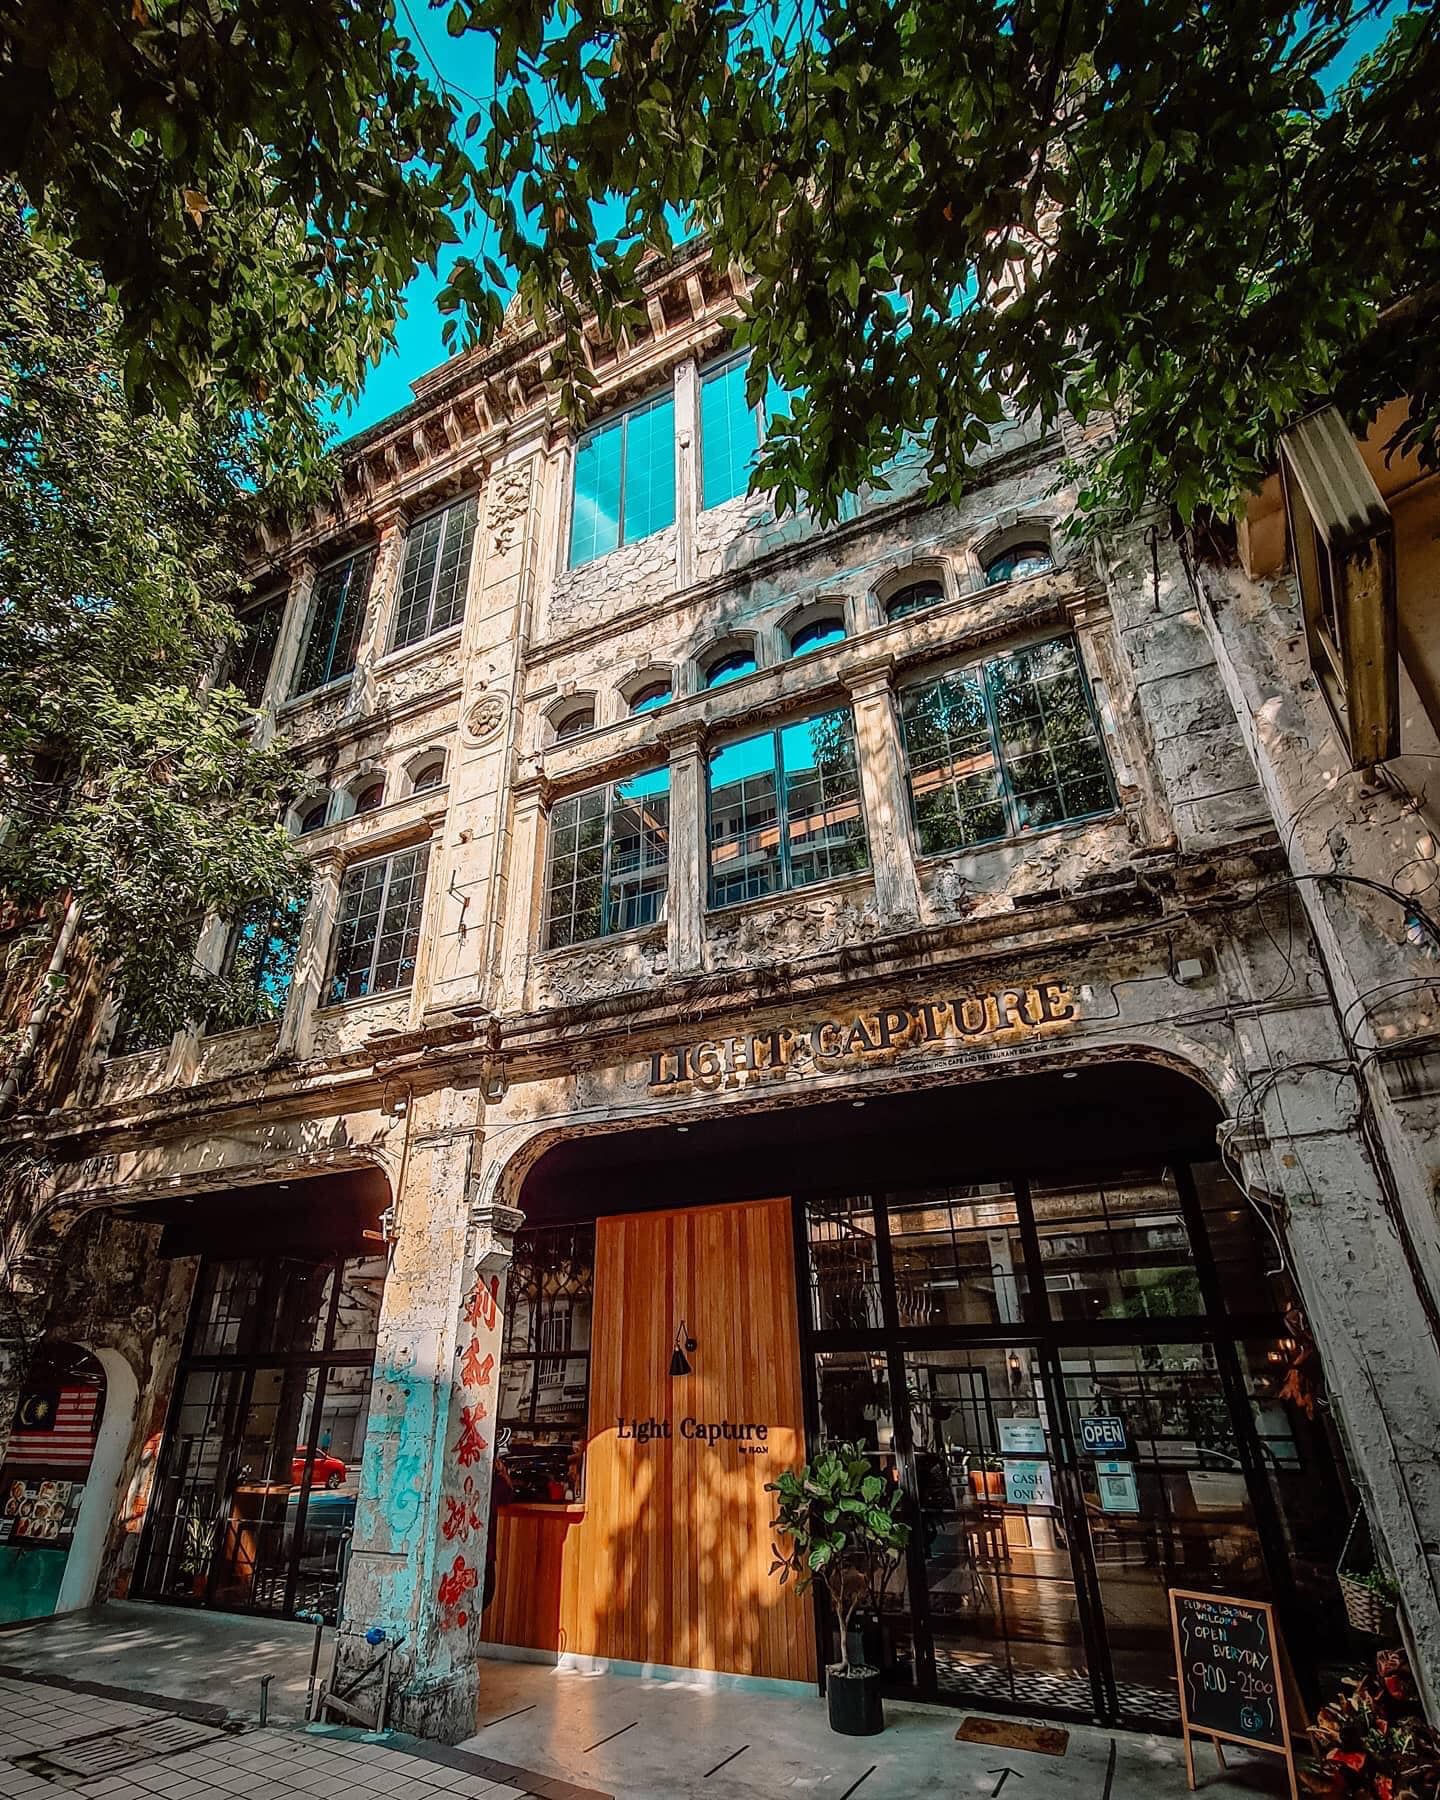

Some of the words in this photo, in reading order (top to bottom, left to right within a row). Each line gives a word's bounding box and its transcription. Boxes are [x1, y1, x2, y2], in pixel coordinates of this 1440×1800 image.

[648, 1024, 792, 1086] LIGHT
[809, 981, 1075, 1060] CAPTURE
[617, 1417, 672, 1444] Light
[680, 1417, 769, 1447] Capture
[1084, 1425, 1123, 1442] OPEN
[1012, 1473, 1044, 1485] CASH
[1013, 1488, 1046, 1500] ONLY
[1194, 1626, 1228, 1642] OPEN
[1212, 1644, 1270, 1671] EVERYDAY
[1192, 1662, 1227, 1693] 9:00
